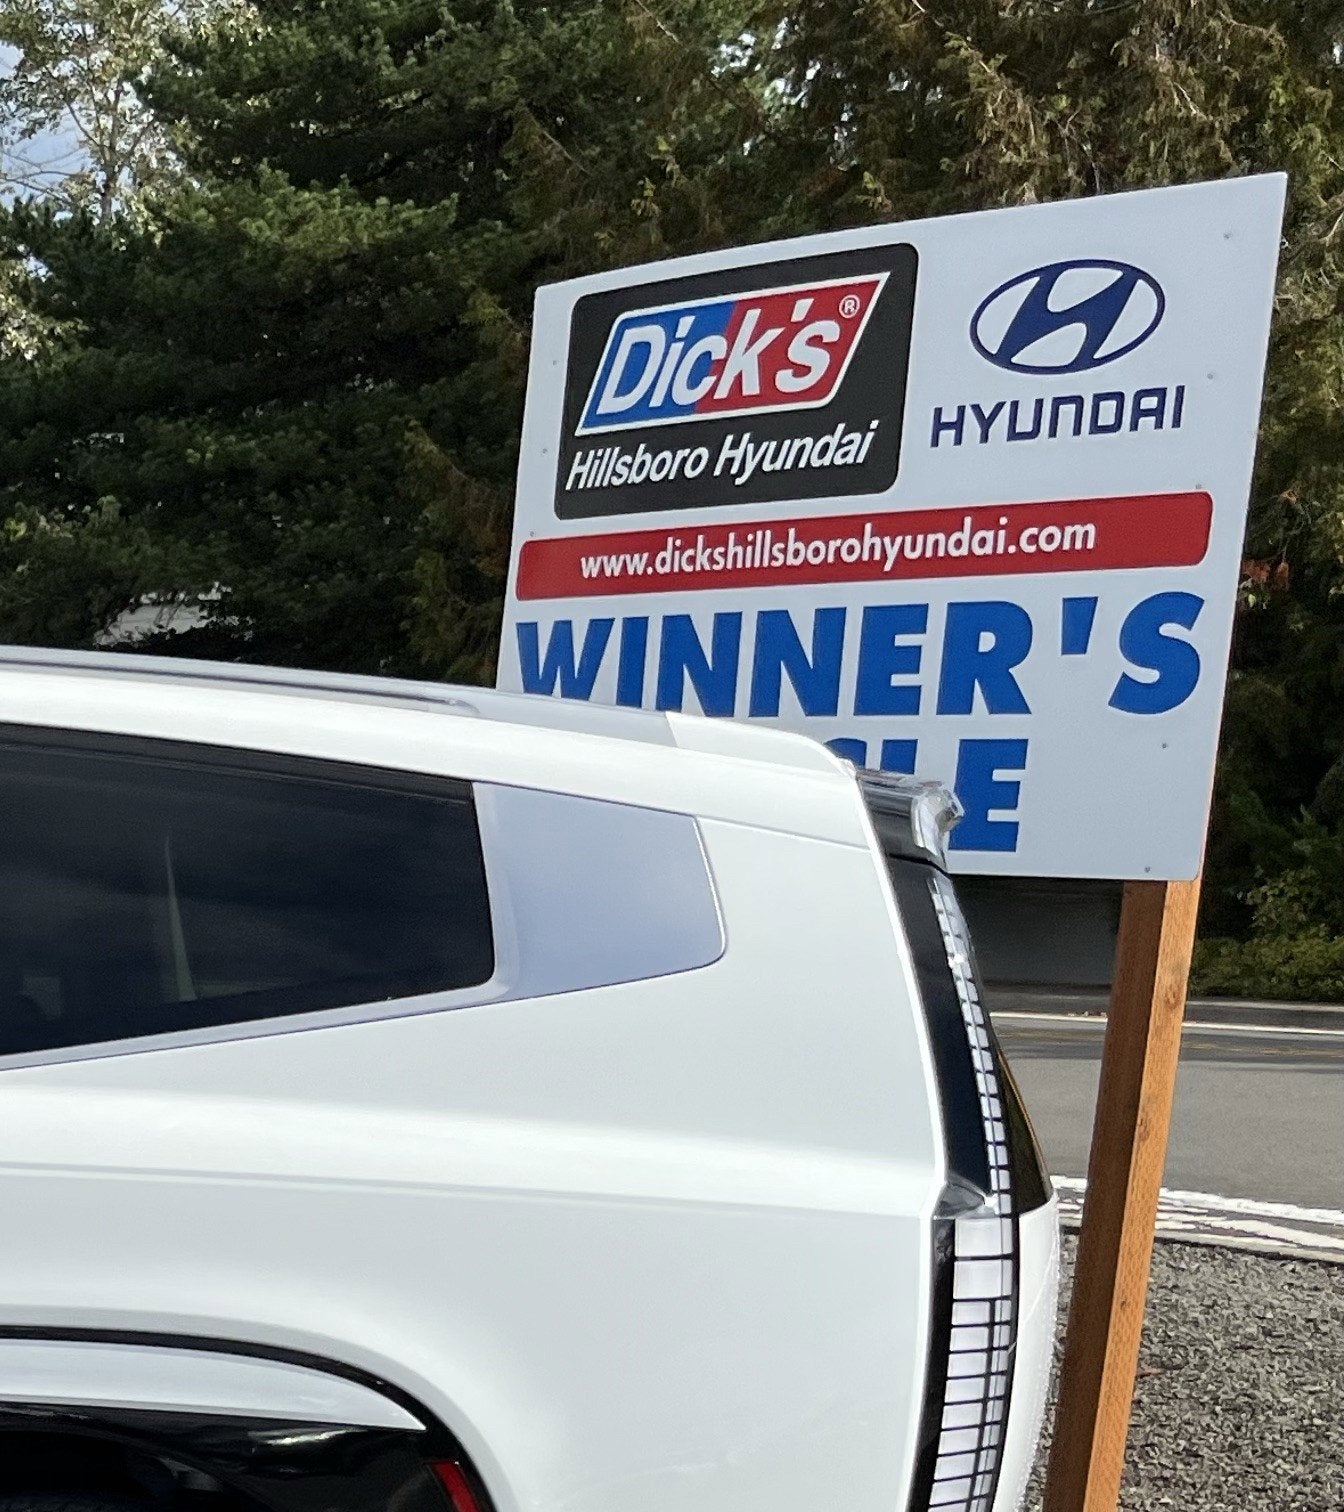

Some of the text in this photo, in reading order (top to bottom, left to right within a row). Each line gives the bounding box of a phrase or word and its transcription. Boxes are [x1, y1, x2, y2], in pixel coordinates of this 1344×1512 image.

[930, 385, 1185, 447] HYUNDAI
[565, 419, 879, 490] Hillsboro Hyundai
[580, 516, 1096, 579] www.dickshillsborohyundai.com
[516, 591, 1205, 717] WINNER'S
